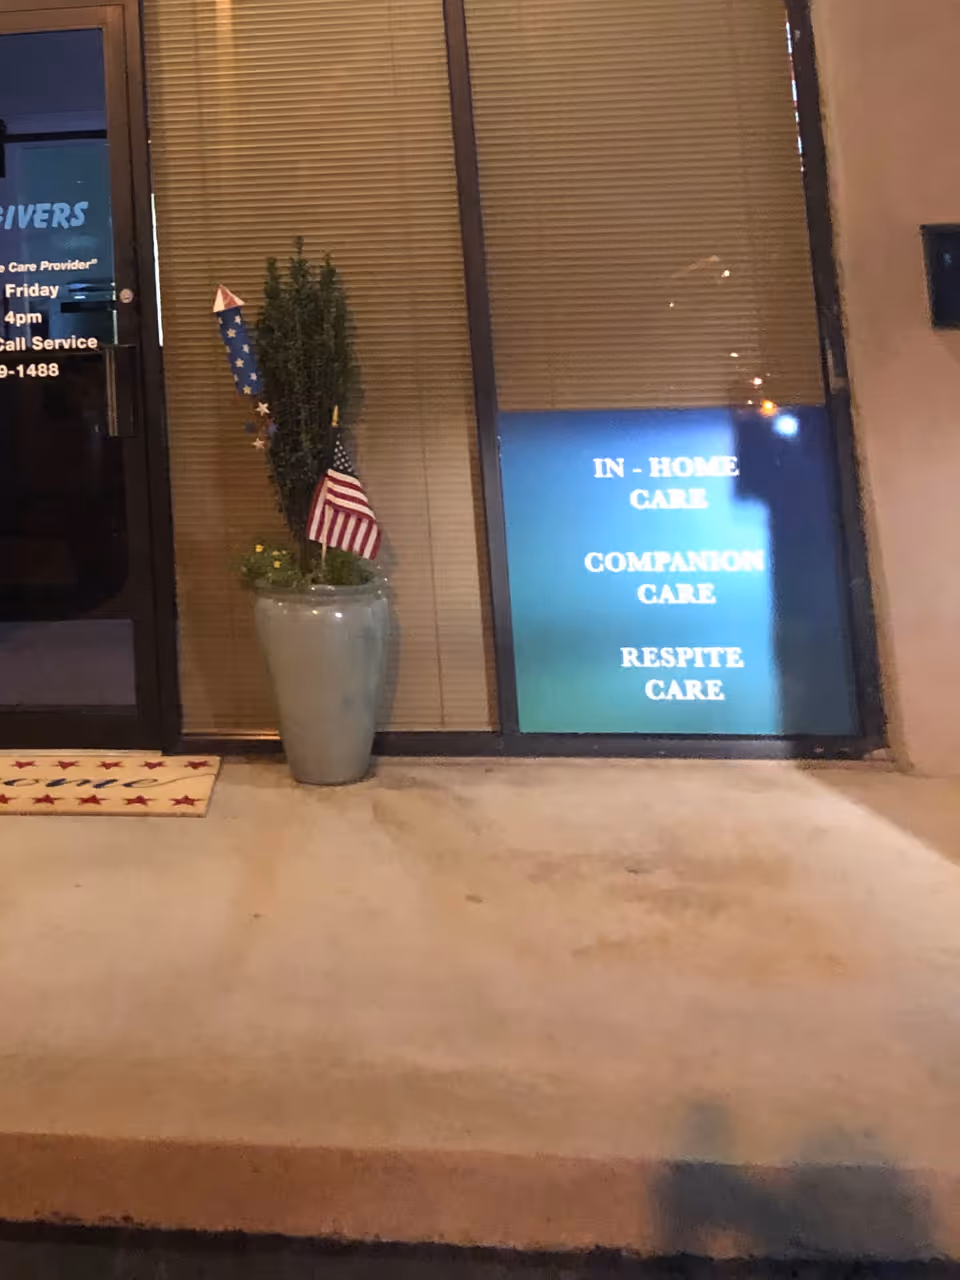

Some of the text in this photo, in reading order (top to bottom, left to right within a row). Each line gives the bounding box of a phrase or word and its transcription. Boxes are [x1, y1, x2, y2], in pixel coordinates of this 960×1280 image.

[8, 260, 37, 273] Care
[4, 283, 59, 299] Friday
[4, 310, 42, 326] 4pm
[31, 335, 98, 350] Service
[593, 458, 625, 478] IN
[649, 456, 740, 477] HOME
[629, 489, 708, 510] CARE
[584, 551, 764, 572] COMPANION
[637, 583, 716, 604] CARE
[620, 647, 744, 668] RESPITE
[645, 679, 725, 700] CARE
